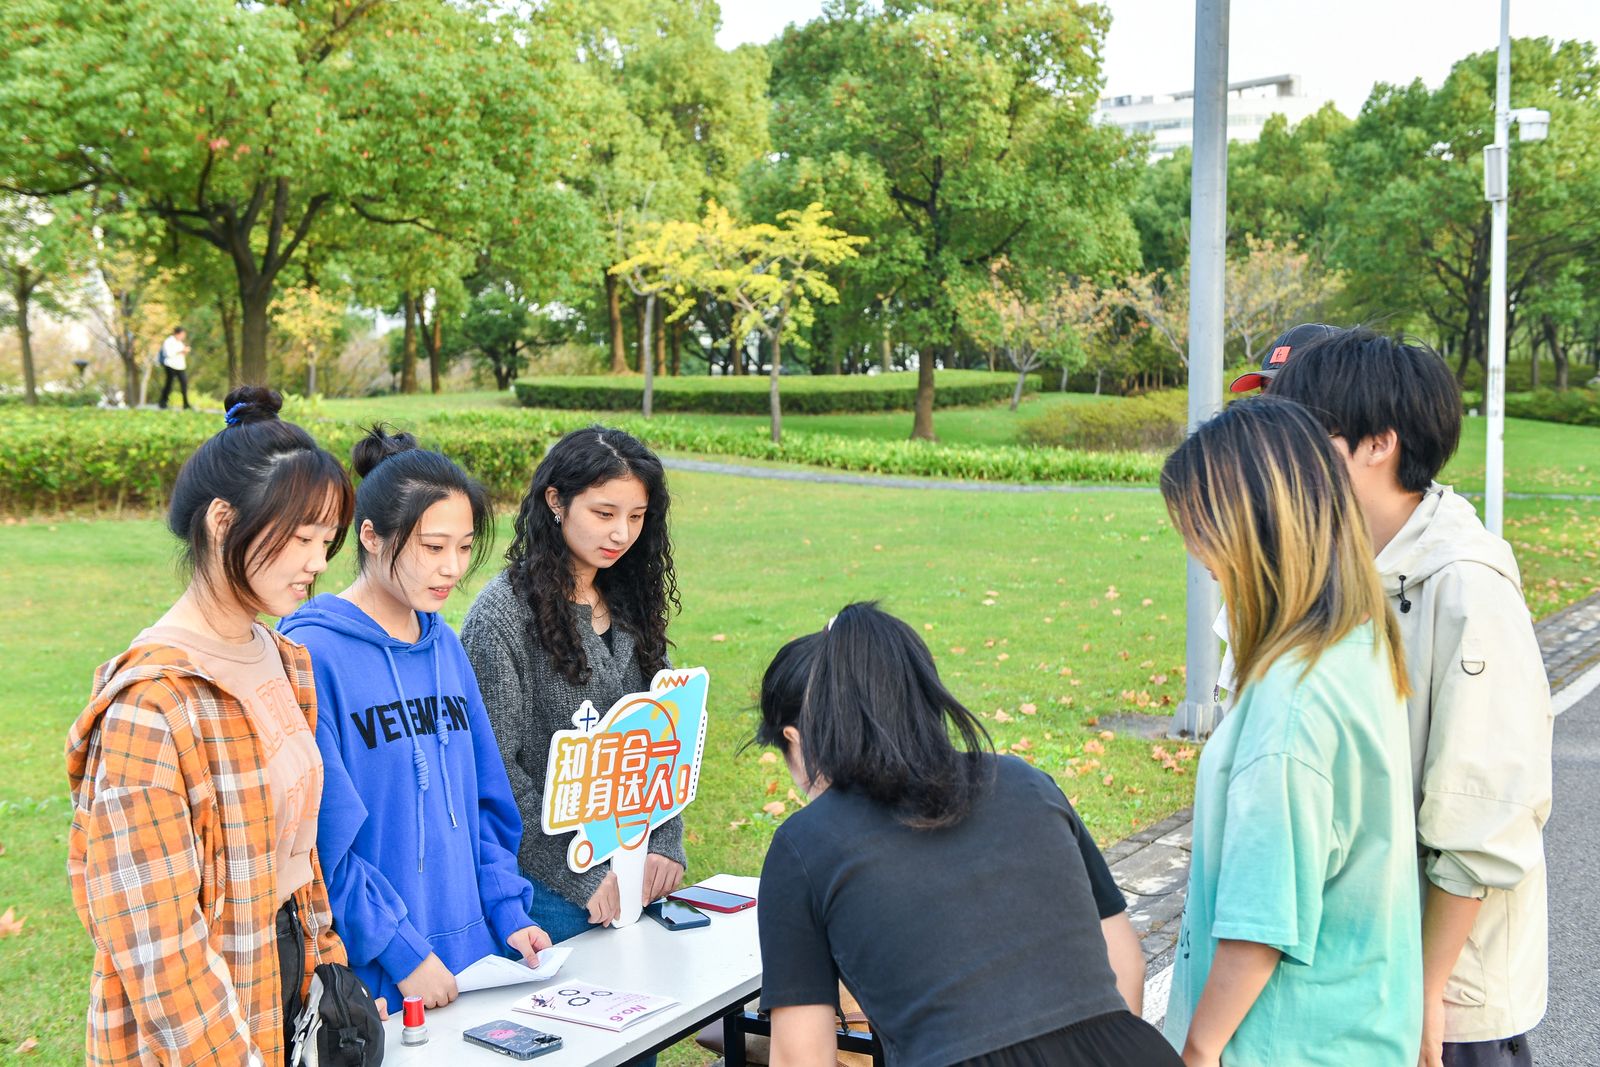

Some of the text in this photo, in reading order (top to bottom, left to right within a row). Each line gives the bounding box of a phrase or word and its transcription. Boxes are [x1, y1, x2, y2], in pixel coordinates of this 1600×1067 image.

[557, 734, 678, 783] 知行合一
[609, 1004, 648, 1023] No.6
